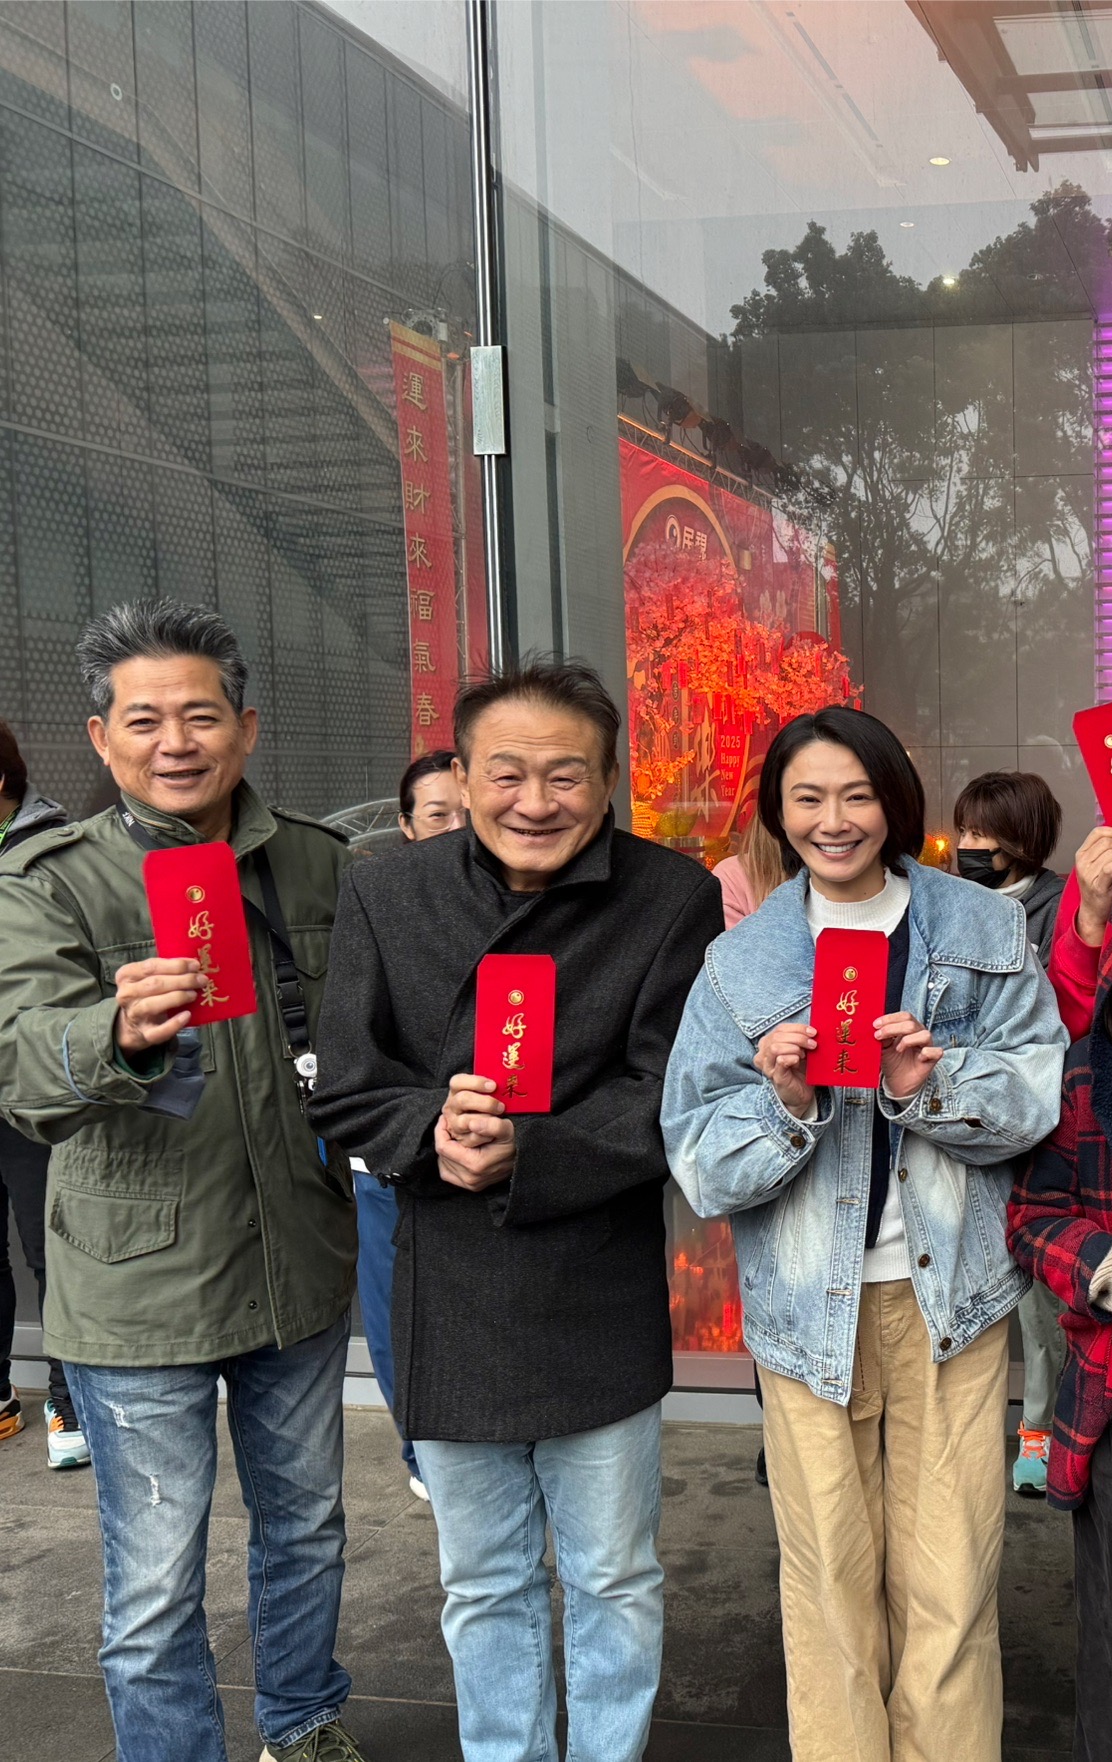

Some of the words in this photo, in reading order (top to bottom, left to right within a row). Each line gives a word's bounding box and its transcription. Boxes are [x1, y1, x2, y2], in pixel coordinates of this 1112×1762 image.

[401, 371, 439, 726] 運來財來福氣春
[720, 734, 741, 748] 2025
[720, 752, 740, 768] Happy
[720, 769, 734, 781] New
[720, 784, 735, 797] Year
